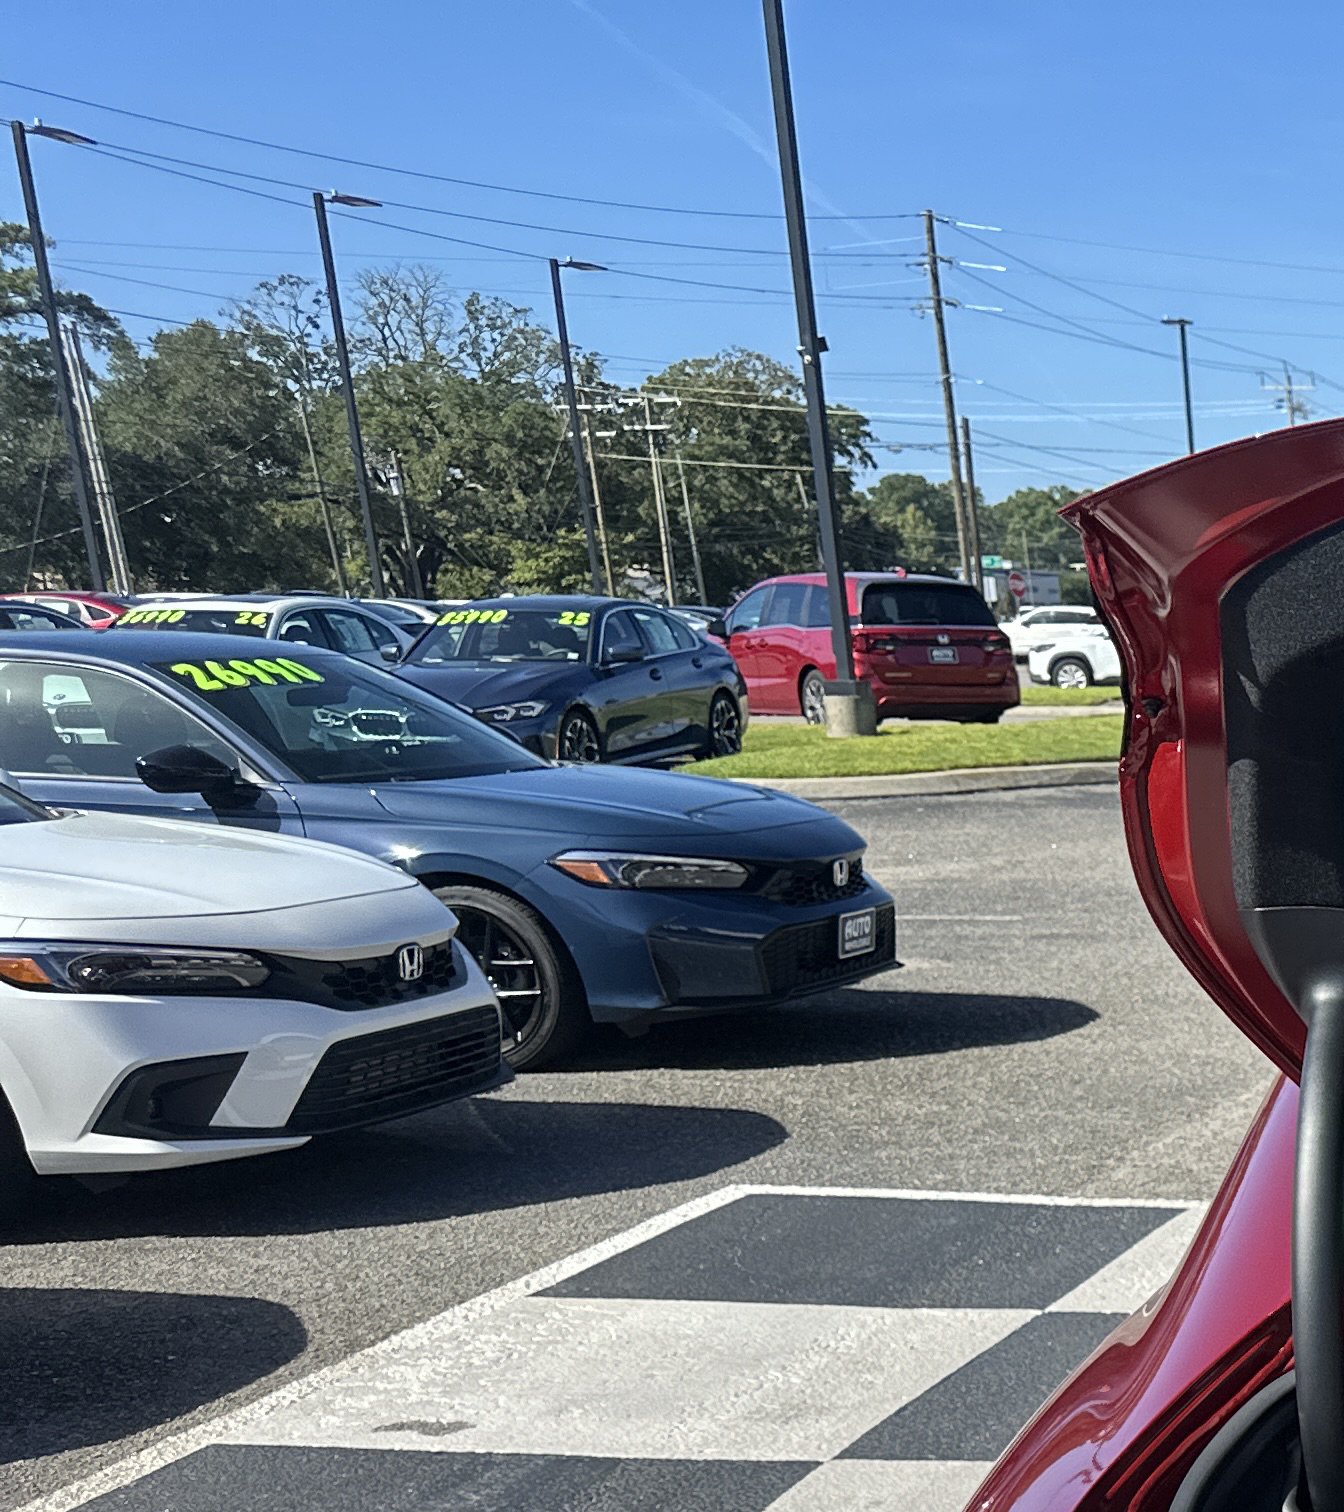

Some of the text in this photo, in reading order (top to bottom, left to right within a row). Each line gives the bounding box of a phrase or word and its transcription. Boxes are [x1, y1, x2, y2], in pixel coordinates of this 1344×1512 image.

[234, 611, 268, 626] 26
[558, 611, 591, 626] 25
[170, 657, 326, 691] 26990
[844, 915, 871, 940] AUTO
